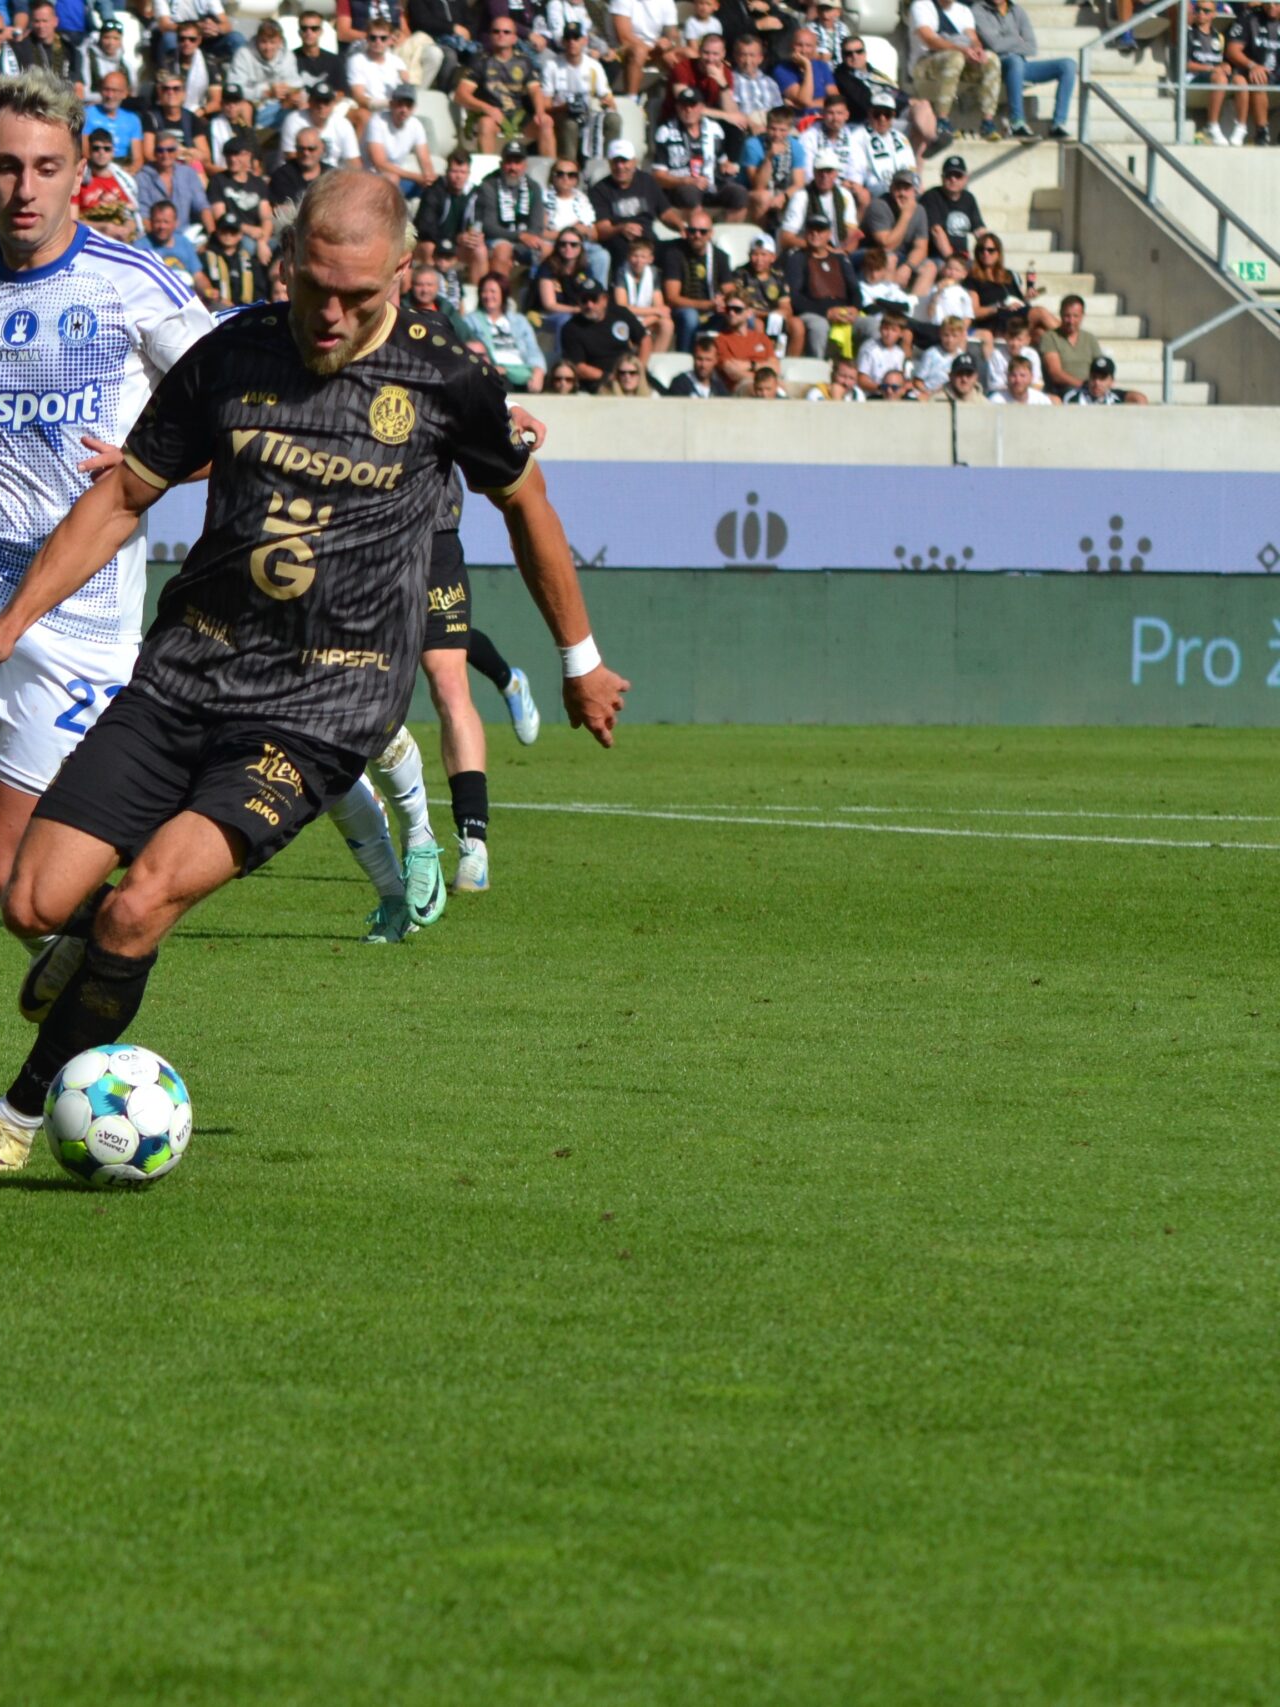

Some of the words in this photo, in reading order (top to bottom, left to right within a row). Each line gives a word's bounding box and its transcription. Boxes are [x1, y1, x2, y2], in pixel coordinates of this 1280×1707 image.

[241, 391, 278, 409] JAKO
[260, 431, 403, 490] Tipsport
[445, 623, 468, 633] JAKO
[1131, 616, 1242, 687] Pro
[54, 678, 127, 735] 2
[244, 798, 280, 826] JAKO
[103, 1130, 129, 1148] LIGA
